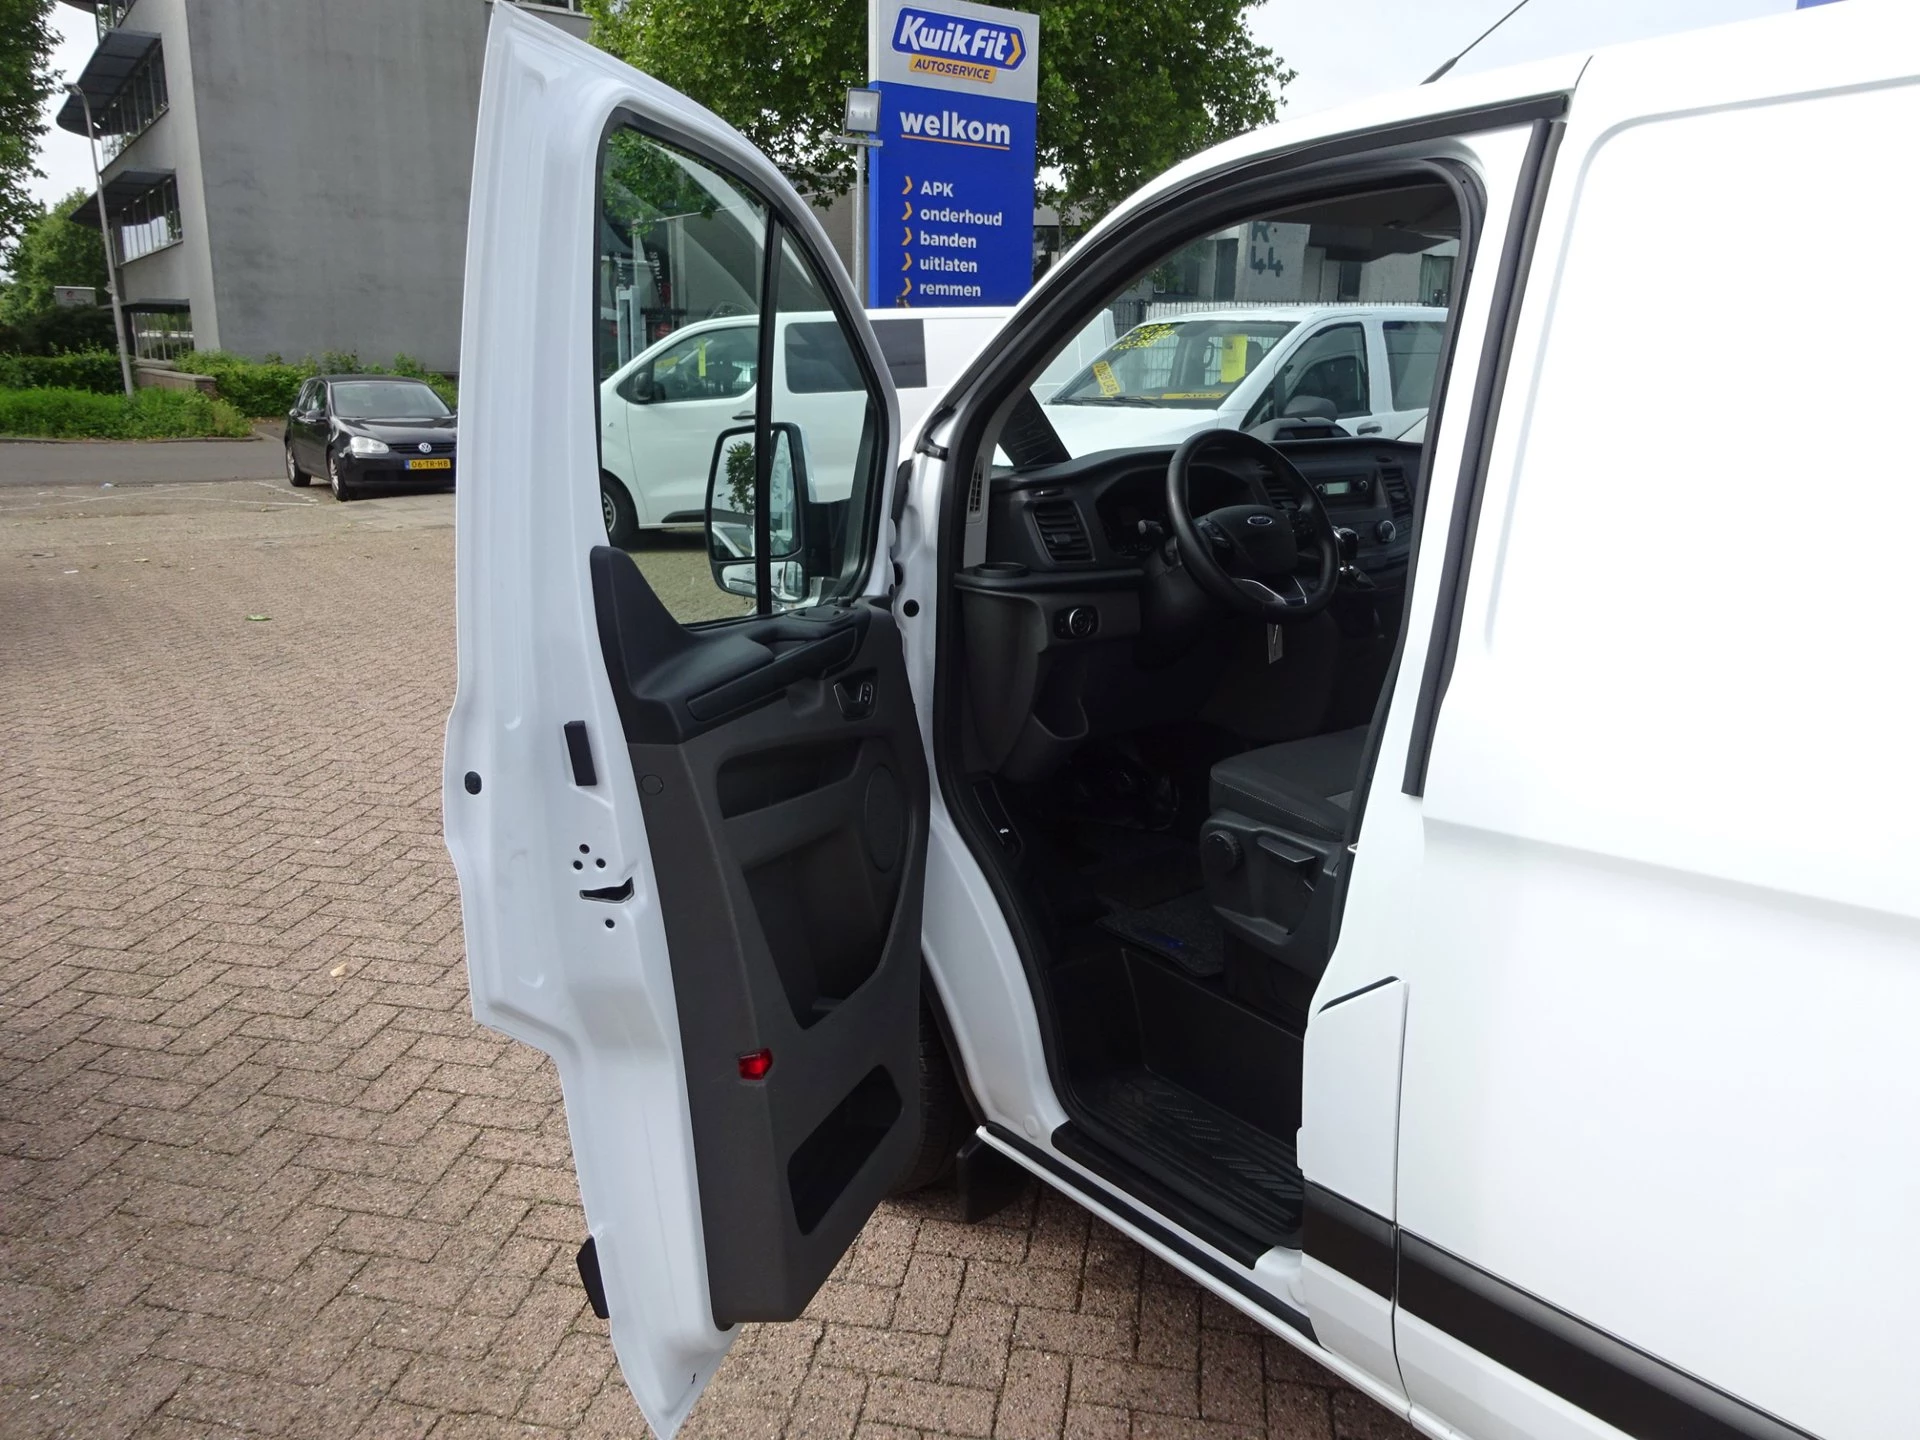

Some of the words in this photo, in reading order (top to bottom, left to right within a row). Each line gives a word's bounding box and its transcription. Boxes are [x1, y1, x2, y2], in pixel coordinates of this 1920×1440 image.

[914, 58, 991, 79] AUTOSERVICE
[900, 111, 1011, 144] welkom
[920, 180, 954, 197] APK
[920, 207, 1003, 226] onderhoud
[920, 231, 977, 249] banden
[920, 257, 978, 273] uitlaten
[1250, 246, 1283, 277] 44
[919, 283, 981, 297] remmen
